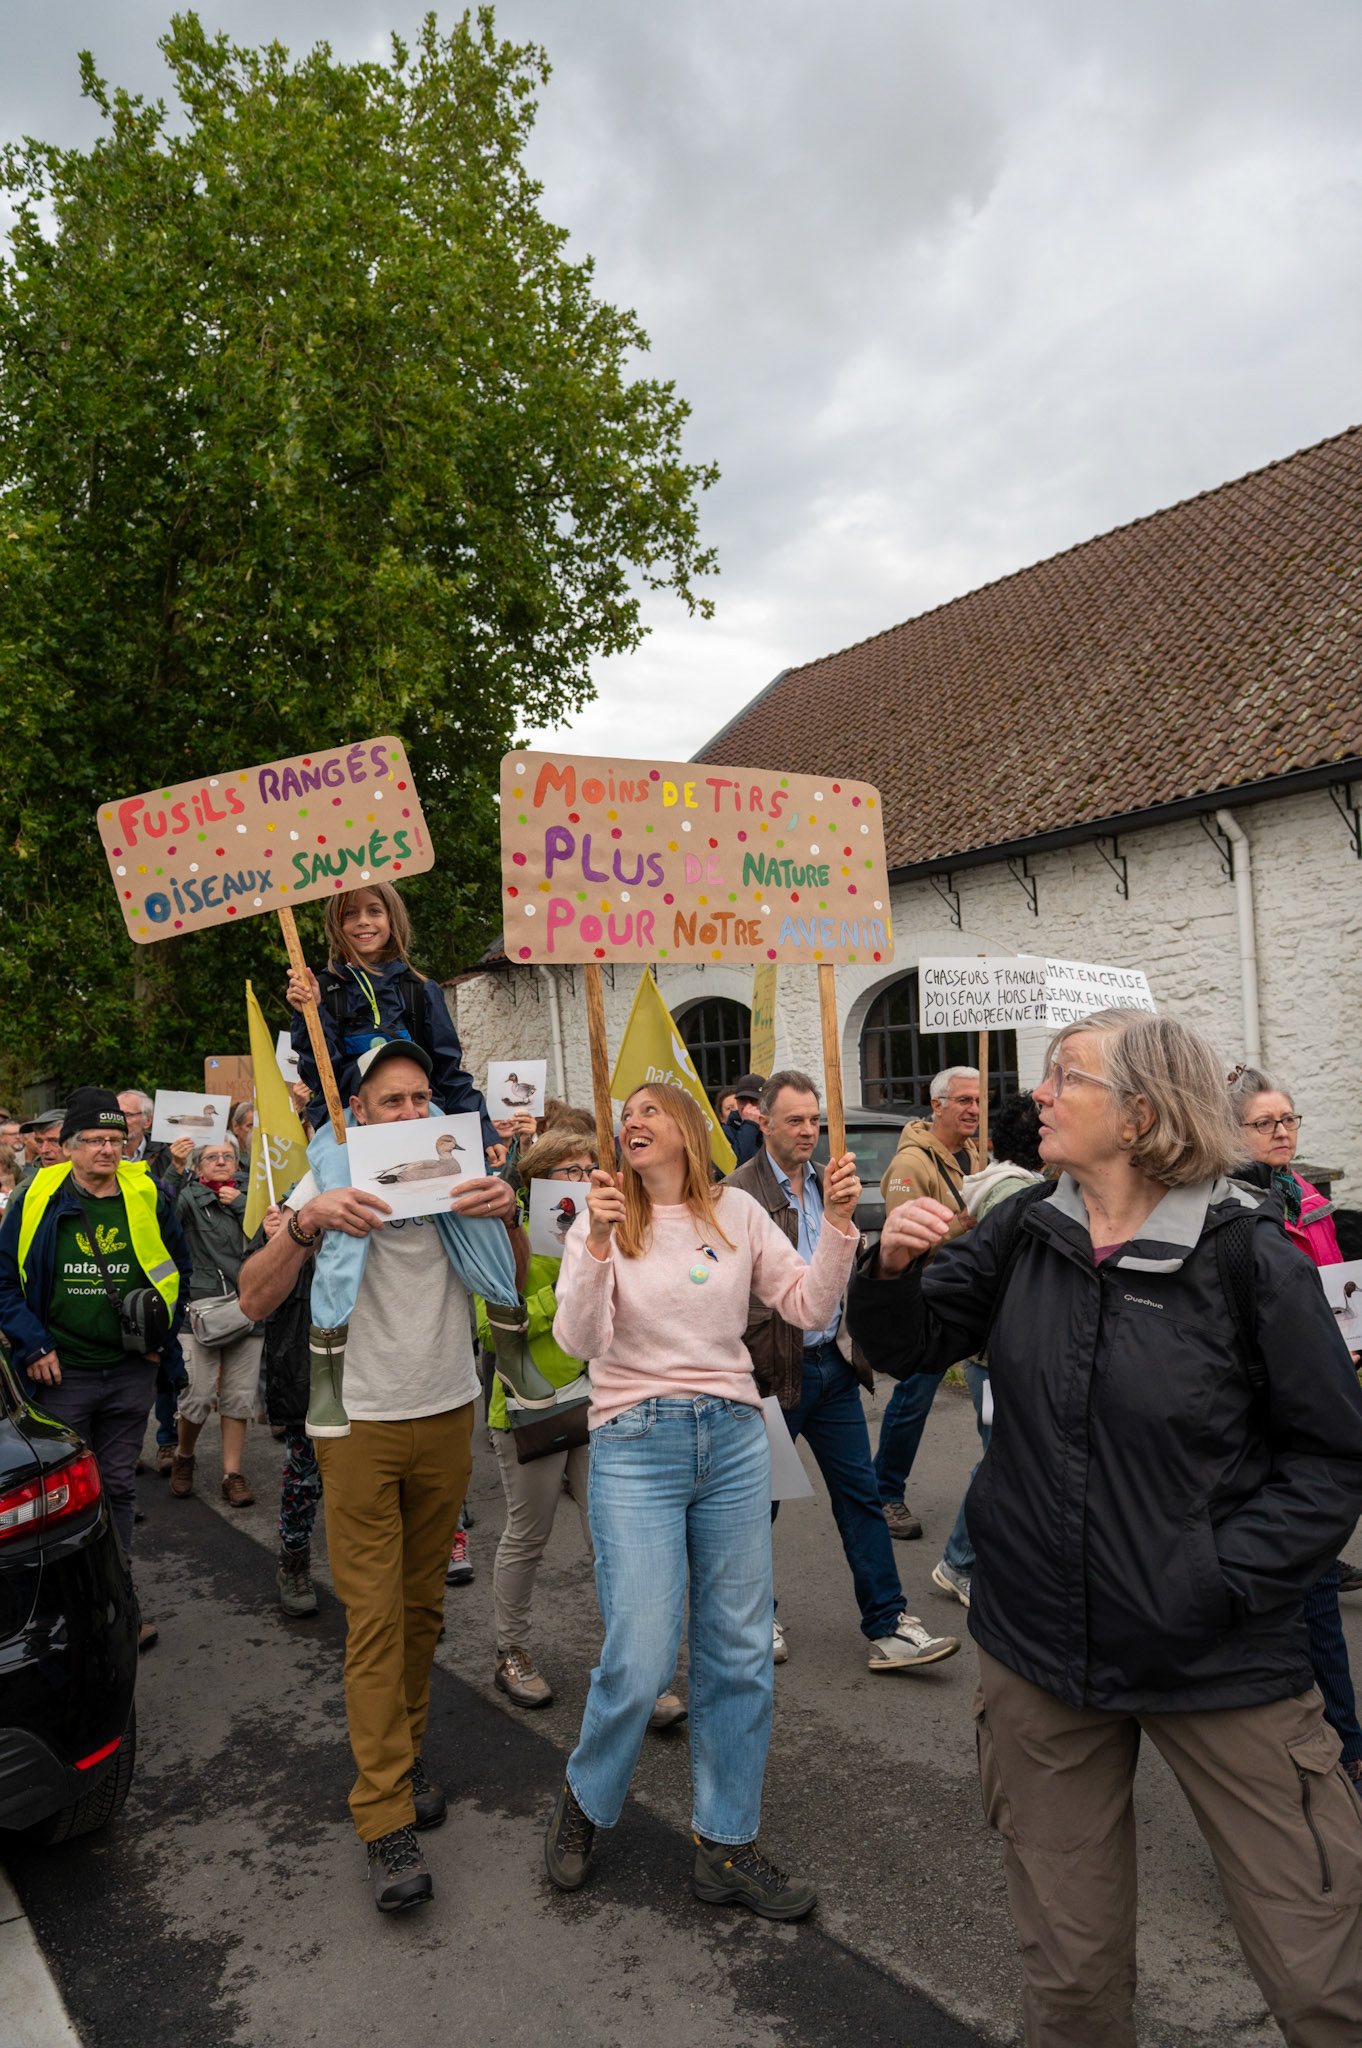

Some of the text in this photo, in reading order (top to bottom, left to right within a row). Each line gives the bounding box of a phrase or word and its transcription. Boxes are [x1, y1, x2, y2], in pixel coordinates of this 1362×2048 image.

[258, 744, 389, 803] RANGÉS
[663, 780, 699, 808] DE
[545, 825, 830, 889] PLUS DE NATURE
[547, 897, 655, 953] POUR
[673, 910, 764, 948] NOTRE
[925, 969, 989, 987] CHASSEURS
[925, 988, 1044, 1009] D'OISEAUX HORS LA
[926, 1010, 949, 1027] LOI
[1124, 1294, 1164, 1309] Quechua
